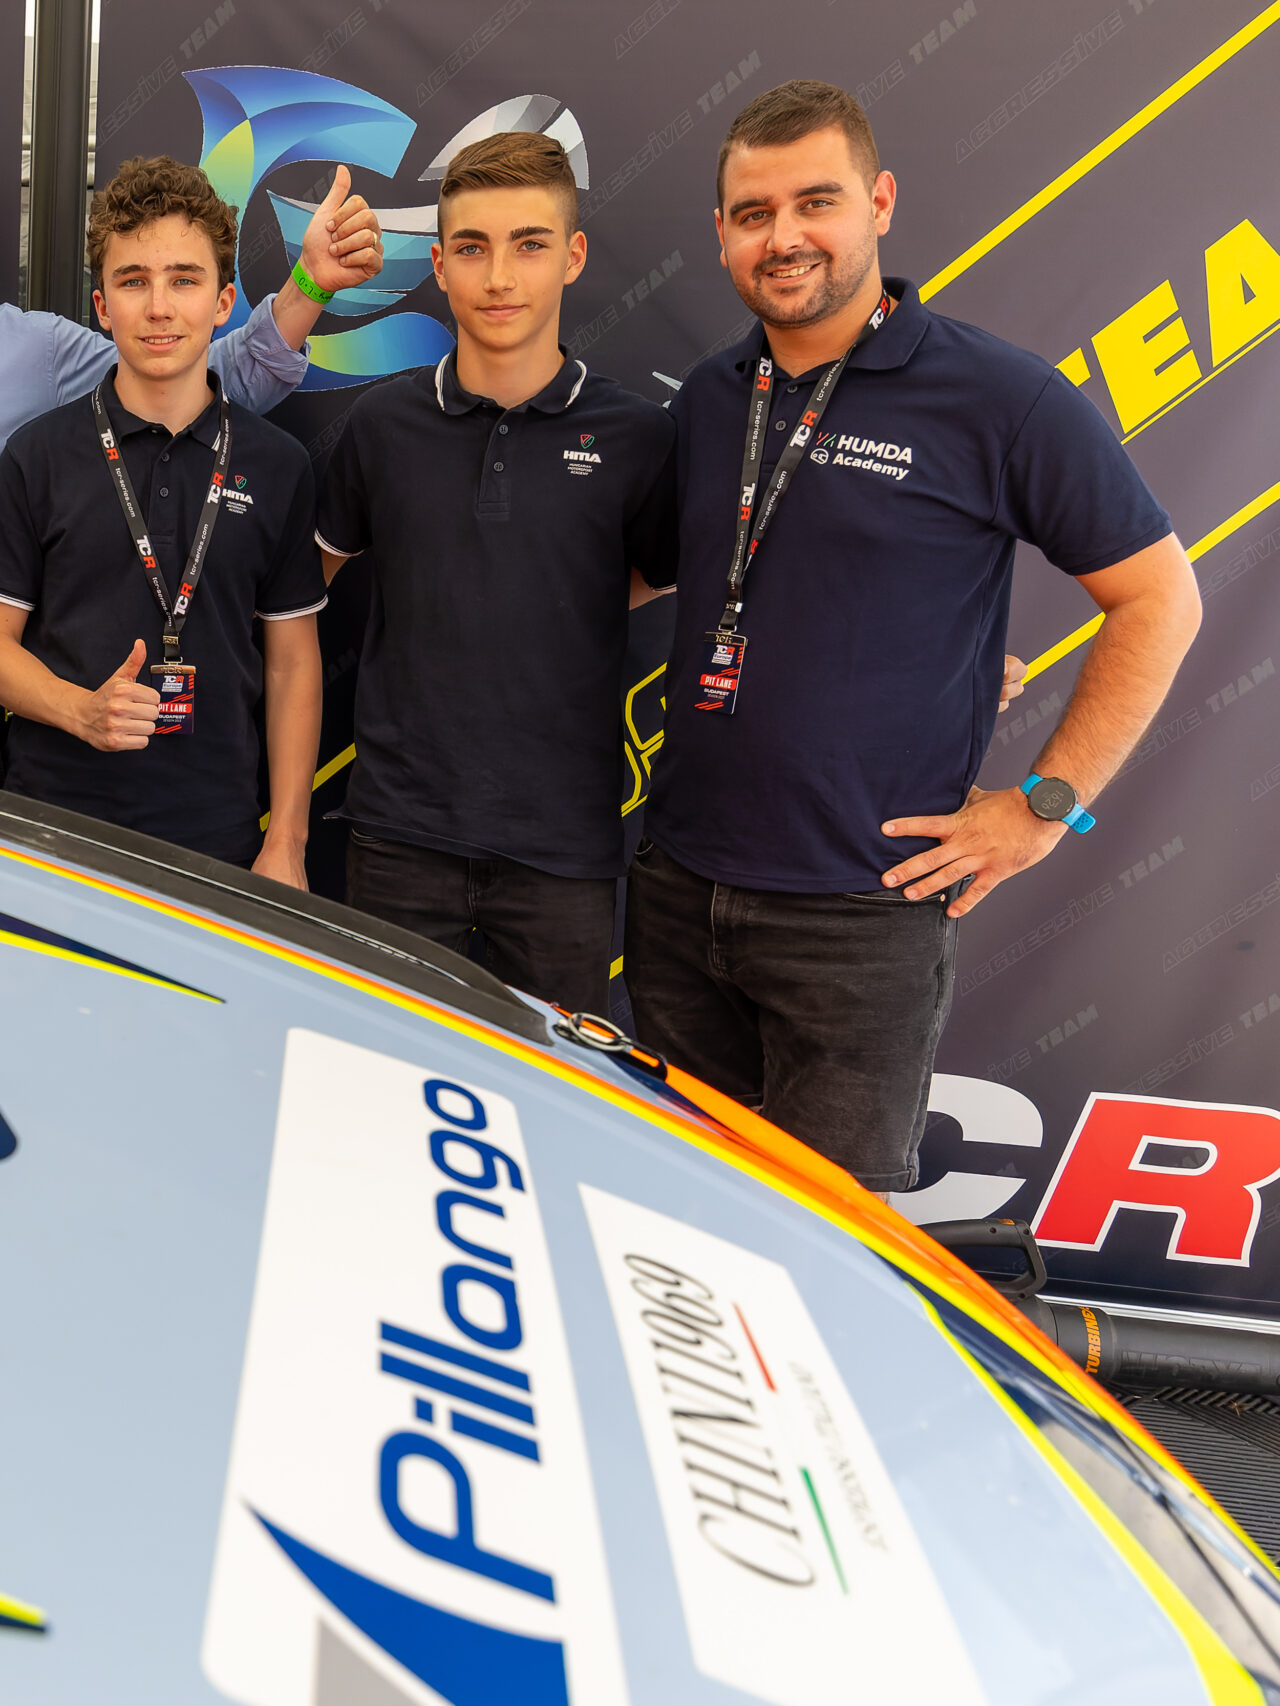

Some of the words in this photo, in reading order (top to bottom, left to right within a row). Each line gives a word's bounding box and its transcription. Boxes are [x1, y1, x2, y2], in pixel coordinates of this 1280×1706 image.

[179, 0, 236, 59] TEAM
[908, 0, 978, 64] TEAM
[696, 49, 762, 114] TEAM
[621, 249, 685, 311] TEAM
[869, 297, 889, 330] TCR
[1054, 218, 1280, 435] EA
[756, 356, 773, 391] TCR
[100, 428, 120, 461] TCR
[749, 400, 764, 461] tcr-series.com
[790, 410, 819, 448] TCR
[837, 434, 913, 464] HUMDA
[206, 471, 224, 504] TCR
[832, 453, 910, 480] Academy
[115, 467, 136, 518] tcr-series.com
[740, 482, 756, 521] TCR
[758, 470, 788, 530] tcr-series.com
[136, 534, 157, 569] TCR
[190, 523, 209, 576] tcr-series.com
[173, 582, 193, 616] TCR
[158, 703, 170, 713] PIT
[170, 703, 187, 713] LANE
[704, 676, 716, 686] PIT
[715, 678, 733, 689] LANE
[1205, 656, 1276, 714] TEAM
[996, 691, 1062, 746] TEAM
[1119, 835, 1187, 889] TEAM
[1035, 1003, 1100, 1054] TEAM
[888, 1073, 1280, 1268] CR
[375, 1076, 559, 1607] Pillango
